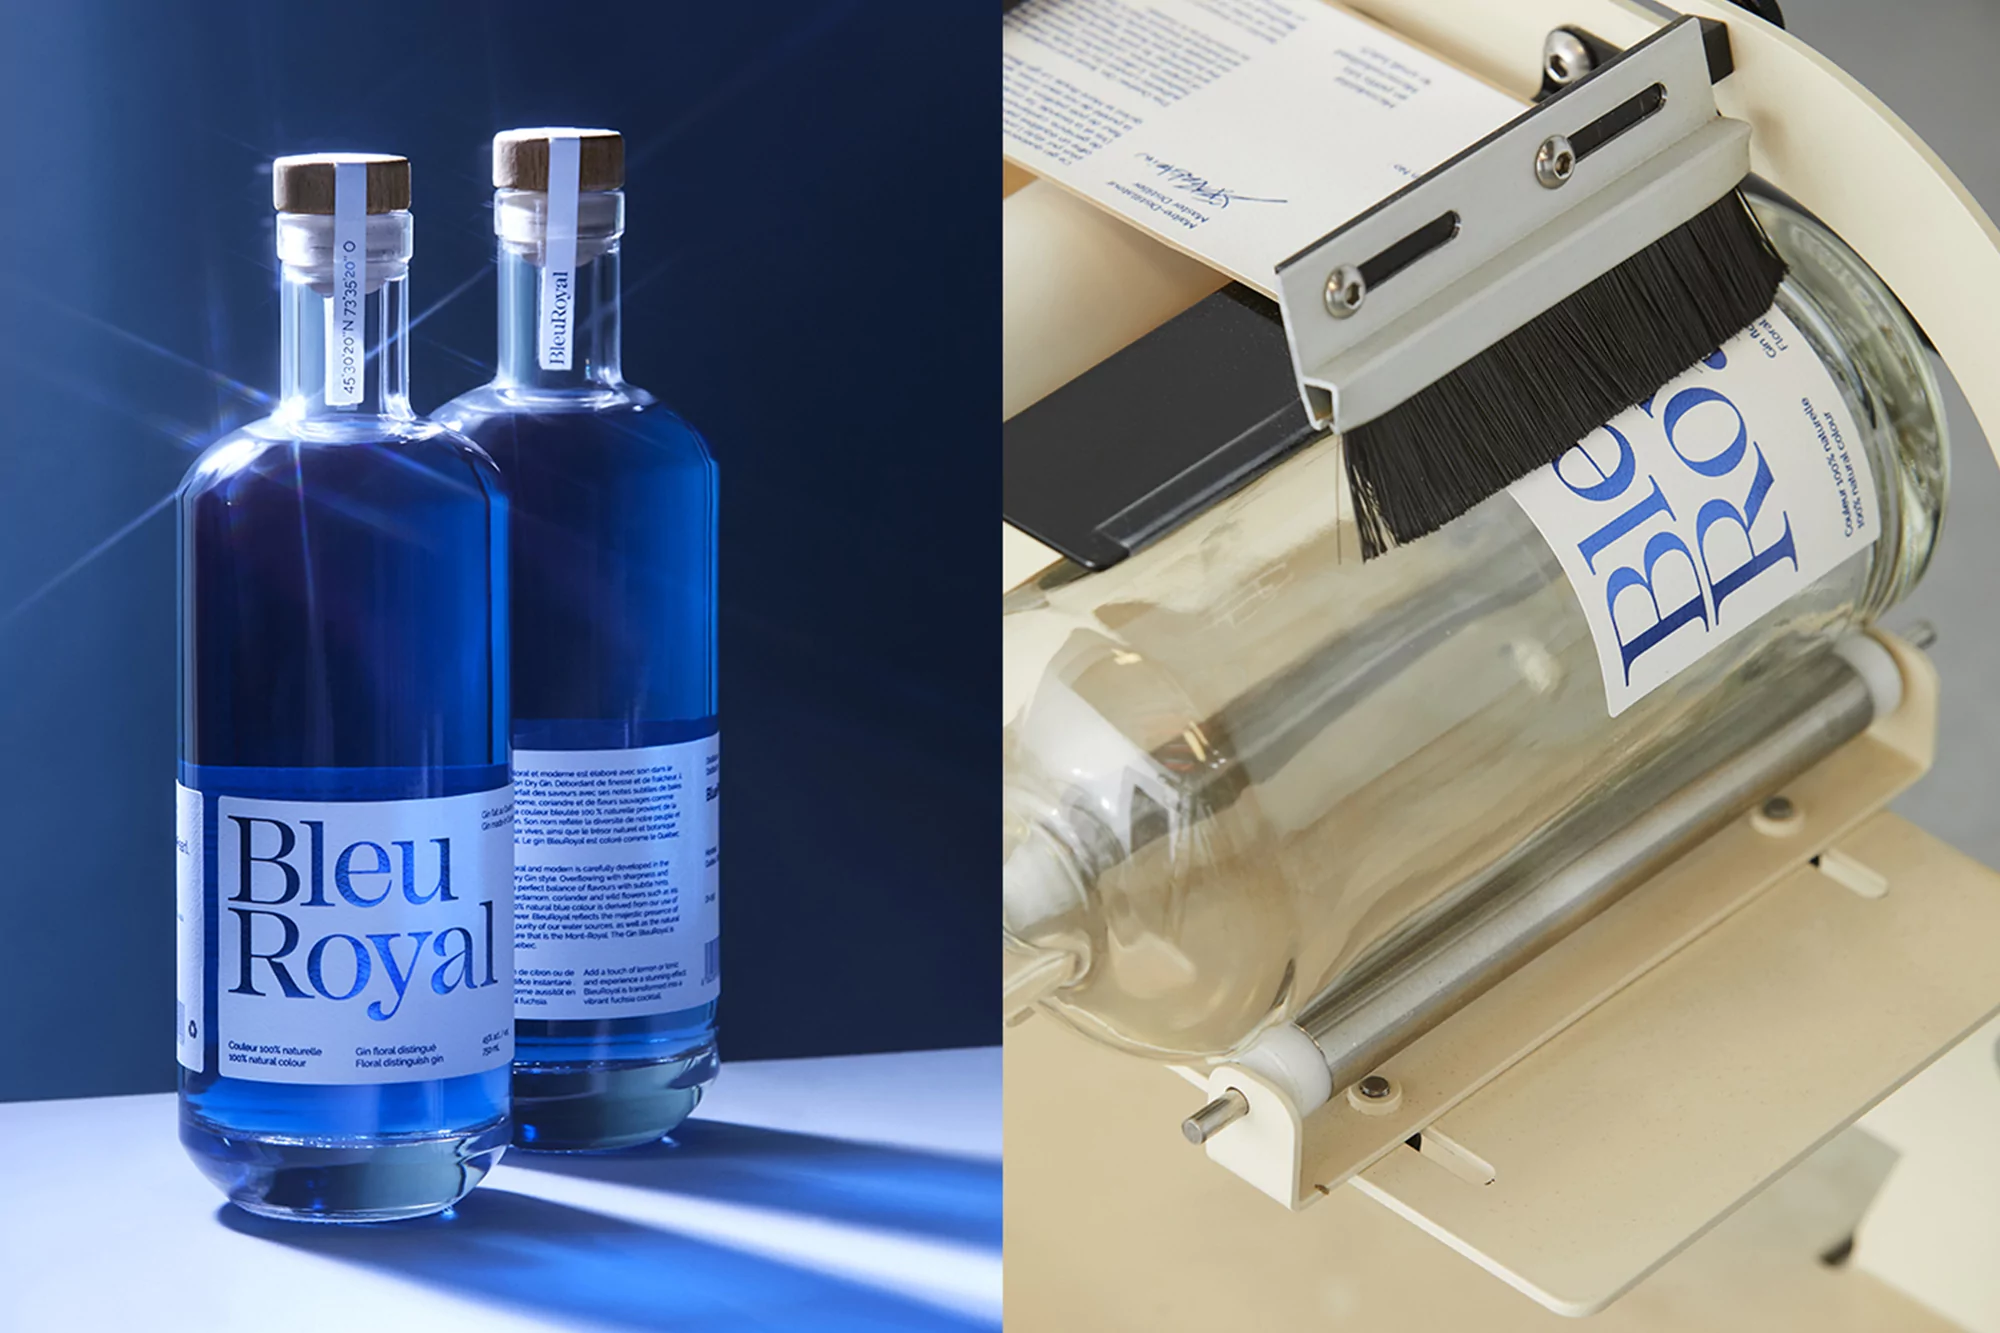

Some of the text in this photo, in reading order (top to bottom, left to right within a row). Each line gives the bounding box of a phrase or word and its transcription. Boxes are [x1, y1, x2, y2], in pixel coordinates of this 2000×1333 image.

[1172, 202, 1209, 223] Master
[549, 271, 571, 365] BleuRoyal
[1759, 319, 1788, 351] Floral
[1760, 338, 1777, 358] Gin
[1801, 397, 1853, 537] Couleur 100% naturelle
[1824, 411, 1865, 528] 100% natural colour
[1640, 347, 1798, 625] Ro
[525, 779, 537, 788] Dry
[596, 779, 606, 787] de
[608, 778, 632, 786] finesse
[597, 798, 618, 806] fleurs
[521, 808, 548, 816] couleur
[604, 806, 635, 814] naturelle
[533, 838, 545, 846] gin
[547, 837, 585, 846] BleuRoyal
[623, 835, 649, 843] comme
[227, 814, 459, 909] Bleu
[544, 865, 573, 873] modern
[583, 864, 614, 873] carefully
[616, 861, 652, 871] developed
[524, 874, 537, 882] Gin
[559, 873, 605, 883] Overflowing
[607, 873, 621, 881] with
[623, 871, 656, 880] sharpness
[518, 880, 653, 892] perfect balance of flavours with subtle
[589, 893, 604, 901] and
[605, 892, 621, 900] wild
[621, 891, 646, 899] flowers
[526, 903, 551, 911] natural
[553, 903, 570, 911] blue
[604, 901, 632, 910] derived
[532, 907, 672, 922] BleuRoyal reflects the majestic presence
[515, 923, 537, 932] purity
[538, 922, 546, 930] of
[547, 923, 560, 931] our
[626, 919, 639, 928] well
[551, 932, 563, 940] the
[611, 930, 624, 938] The
[626, 929, 637, 938] Gin
[227, 900, 499, 1021] Royal
[530, 969, 551, 977] citron
[583, 968, 600, 976] Add
[607, 967, 627, 975] touch
[628, 966, 636, 974] of
[637, 964, 657, 973] lemon
[600, 977, 638, 986] experience
[645, 972, 671, 982] stunning
[584, 987, 620, 996] BleuRoyal
[628, 982, 667, 993] transformed
[584, 995, 636, 1005] vibrant fuchsia
[228, 1040, 323, 1056] Couleur 100% naturelle
[355, 1043, 437, 1056] Gin floral distingué
[229, 1053, 306, 1067] 100% natural colour
[356, 1054, 444, 1068] Floral distinguish gin
